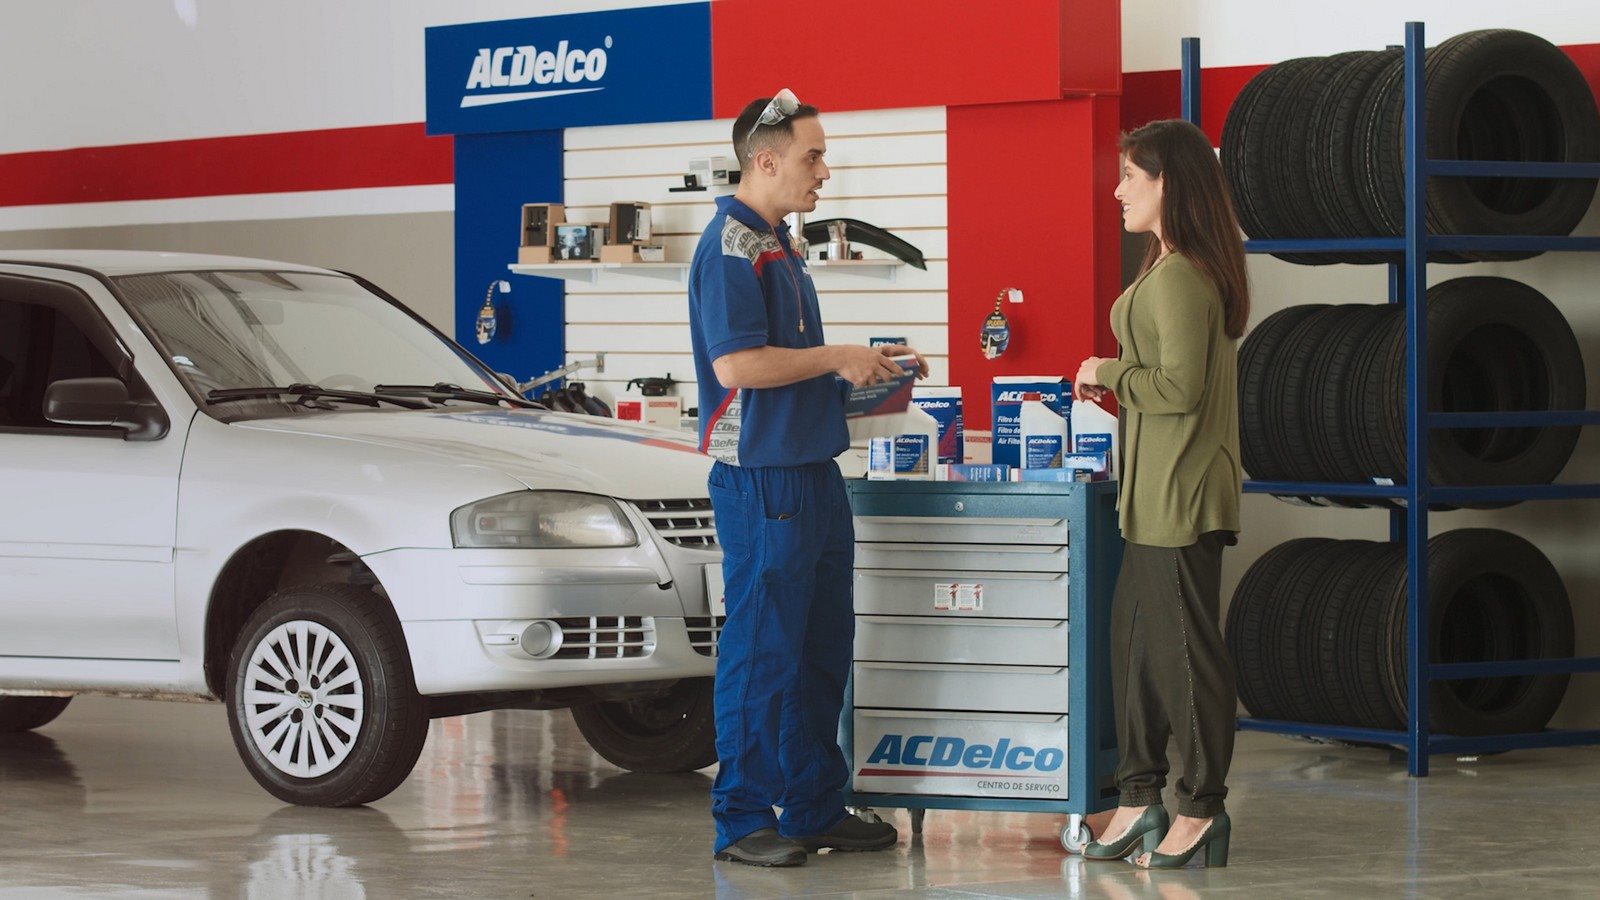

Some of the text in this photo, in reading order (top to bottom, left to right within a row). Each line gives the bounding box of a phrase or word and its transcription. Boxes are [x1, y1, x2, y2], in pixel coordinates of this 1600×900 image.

[466, 40, 607, 89] ACDelco
[998, 391, 1056, 402] ACDco
[866, 734, 1064, 772] ACDelco
[977, 781, 1010, 790] CENTRO
[1025, 783, 1060, 793] SERVIÇO
